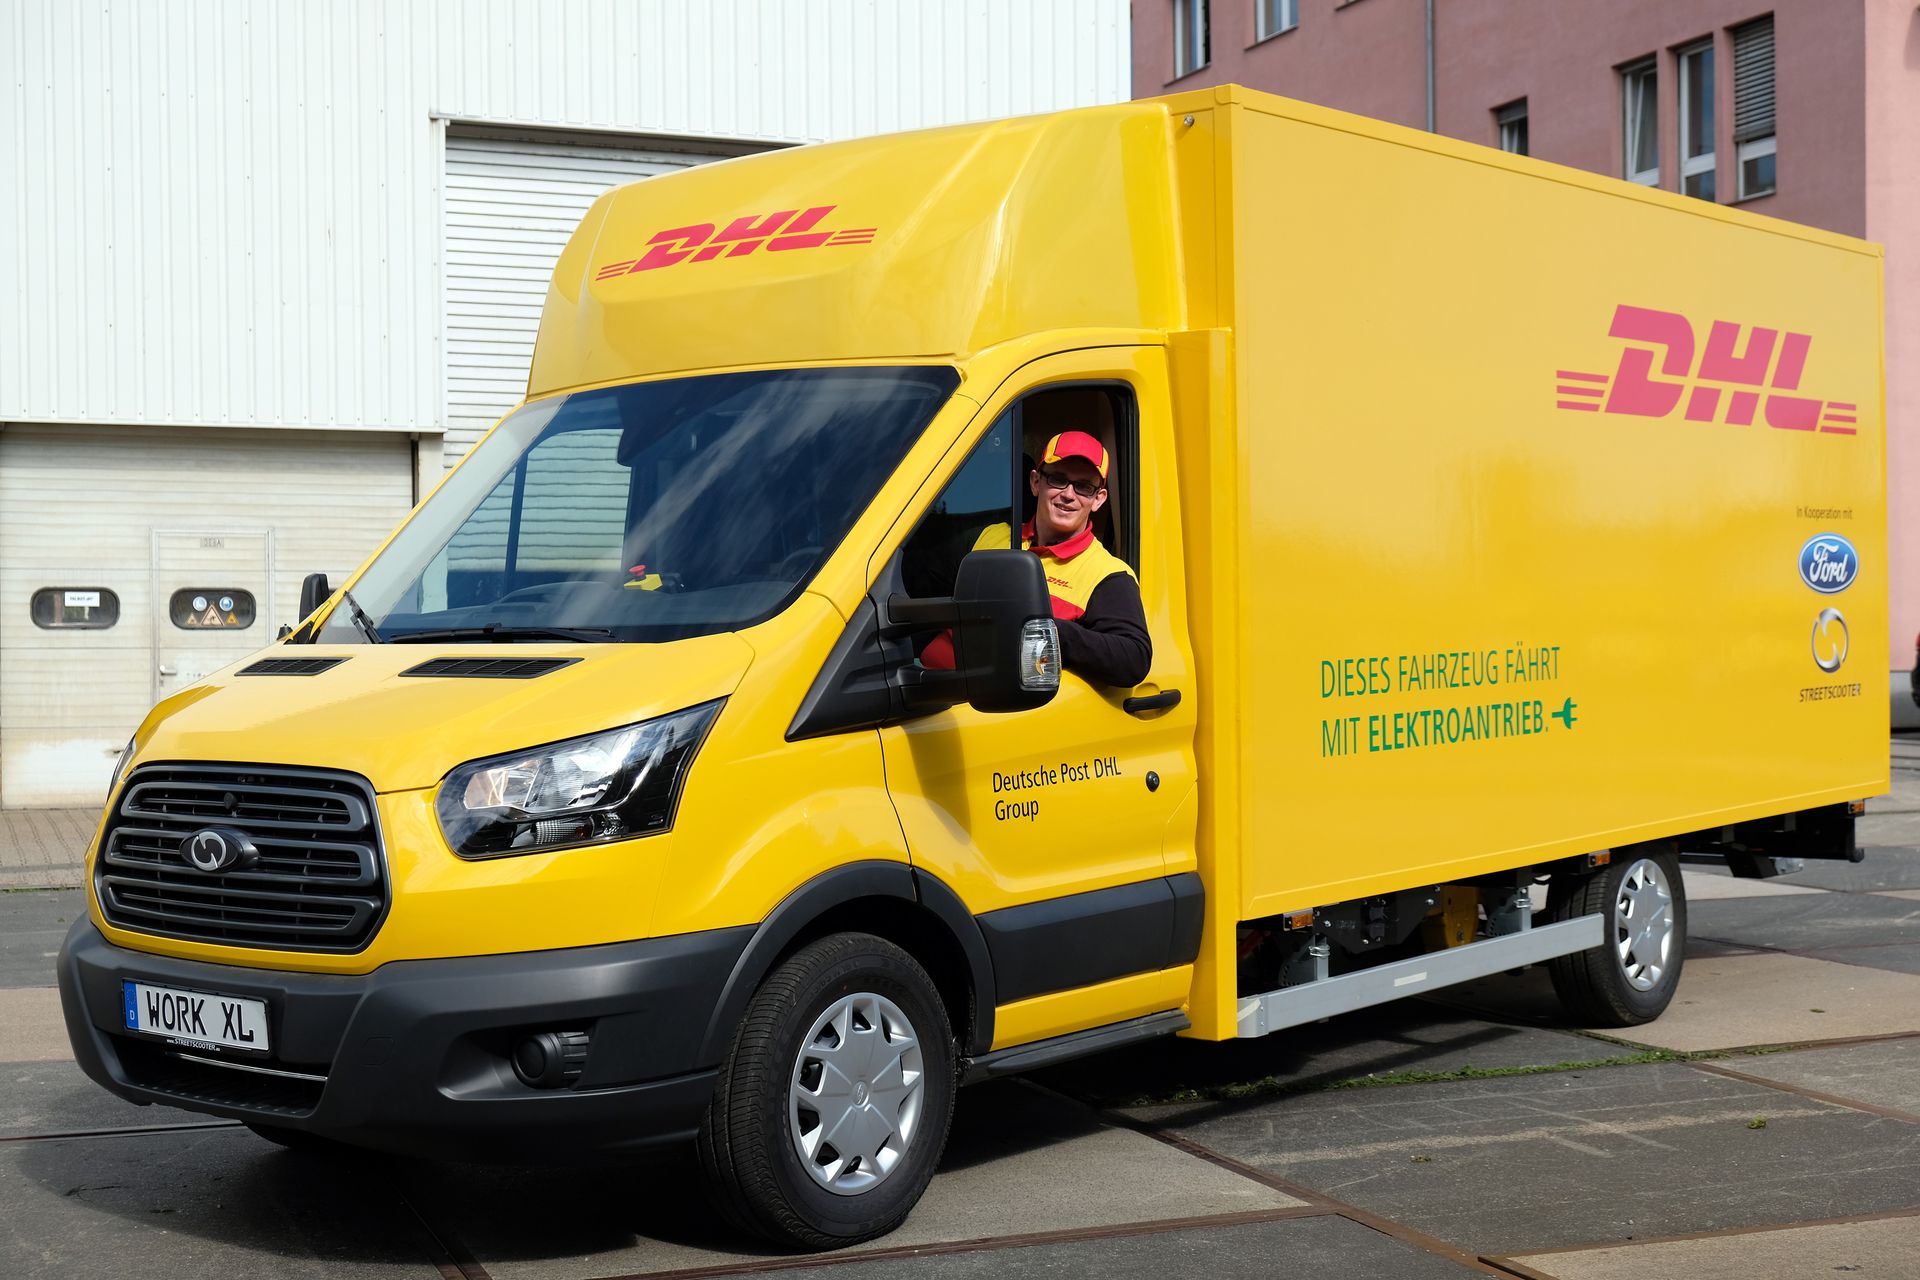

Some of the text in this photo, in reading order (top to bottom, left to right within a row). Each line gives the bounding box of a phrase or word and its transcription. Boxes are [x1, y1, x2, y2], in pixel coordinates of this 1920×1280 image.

[627, 204, 838, 274] DHL
[1604, 303, 1824, 432] DHL
[1804, 506, 1841, 521] Kooperation
[1321, 641, 1560, 698] DIESES FAHRZEUG FÄHRT
[1799, 683, 1861, 703] STREETSCOOTER
[1322, 700, 1549, 758] MIT ELEKTROANTRIEB.
[992, 756, 1122, 793] Deutsche Post DHL
[994, 799, 1039, 822] Group
[129, 990, 254, 1042] D WORK XL
